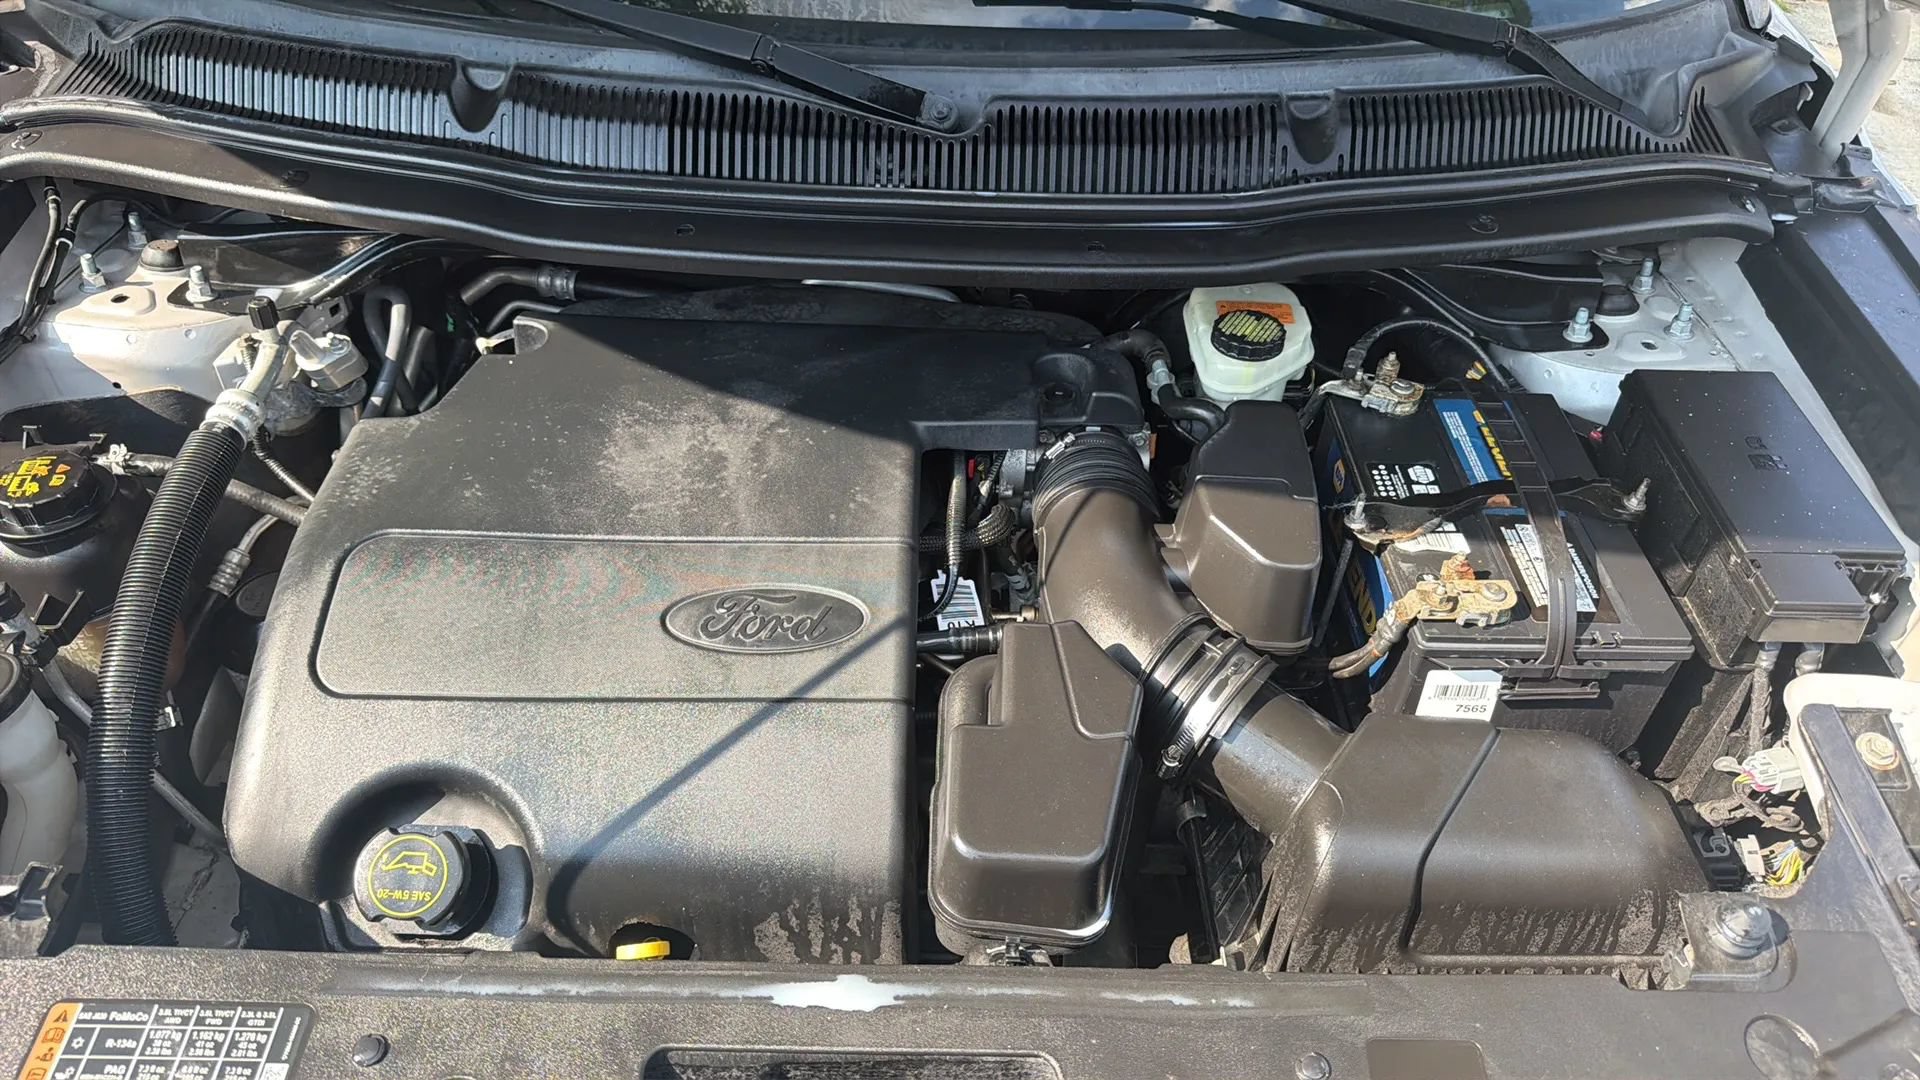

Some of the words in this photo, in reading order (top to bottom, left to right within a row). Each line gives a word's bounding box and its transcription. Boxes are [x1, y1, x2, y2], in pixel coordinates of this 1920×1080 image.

[700, 592, 833, 641] Ford
[1455, 704, 1487, 713] 7565
[377, 888, 409, 901] 5W-20
[411, 890, 432, 901] SAE
[109, 1011, 149, 1022] FoMoCo
[149, 1029, 171, 1039] 1.077
[171, 1030, 183, 1042] kg
[213, 1031, 225, 1043] kg
[256, 1032, 268, 1044] kg
[105, 1038, 138, 1048] R-134a
[104, 1064, 127, 1075] PAG
